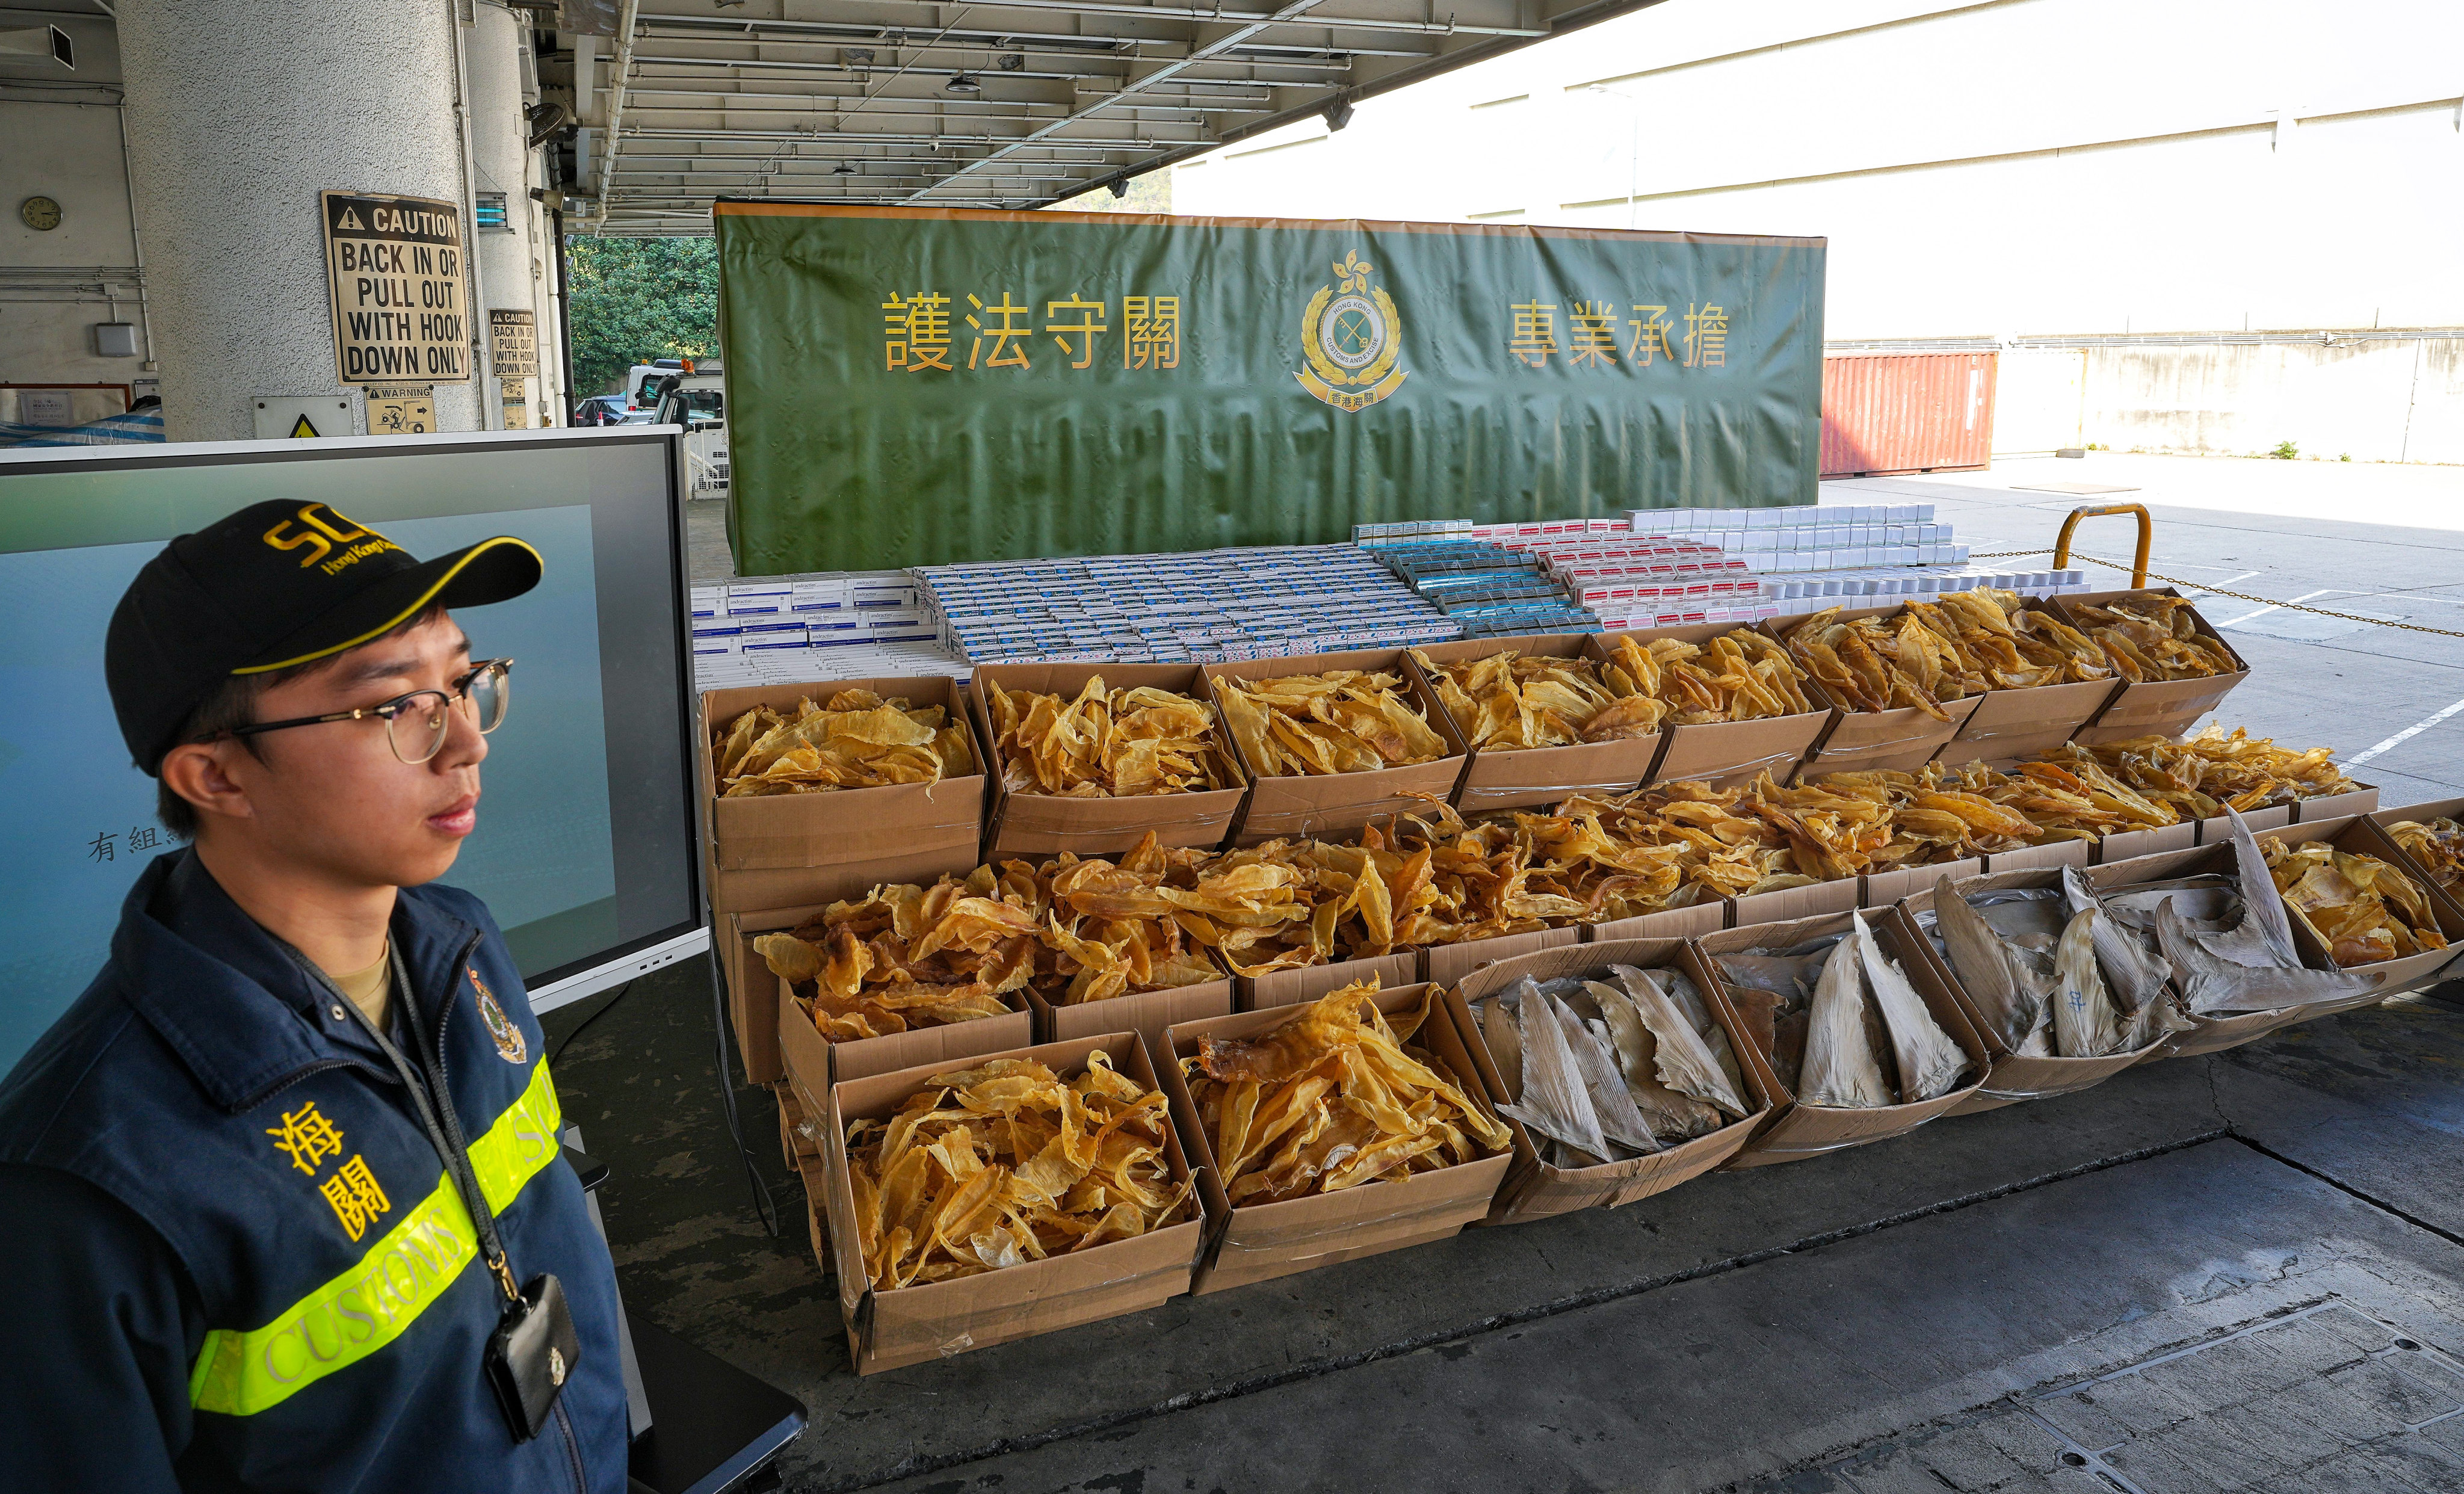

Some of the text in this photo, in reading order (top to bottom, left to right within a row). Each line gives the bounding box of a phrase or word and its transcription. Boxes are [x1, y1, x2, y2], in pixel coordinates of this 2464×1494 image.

[373, 208, 456, 238] CAUTION
[341, 242, 459, 277] BACK IN OR
[357, 277, 453, 309] PULL OUT
[504, 313, 533, 324] CAUTION
[1333, 301, 1371, 315] HONG KONG
[348, 312, 463, 342] WITH HOOK
[494, 326, 533, 338] BACK IN OR
[882, 291, 1179, 372] 護法守關
[1509, 298, 1729, 368] 專業承擔
[496, 350, 535, 362] WITH HOOK
[499, 338, 531, 350] PULL OUT
[1326, 337, 1349, 363] CUSTOMS
[1363, 337, 1379, 360] EXCISE
[347, 346, 465, 375] DOWN ONLY
[496, 363, 536, 374] DOWN ONLY
[381, 388, 430, 398] WARNING
[1331, 392, 1374, 407] 香港海關
[320, 551, 360, 576] Hong
[348, 539, 384, 558] Kong
[88, 826, 177, 863] 有組
[265, 1100, 391, 1242] 海關
[265, 1208, 463, 1384] CUSTOMS
